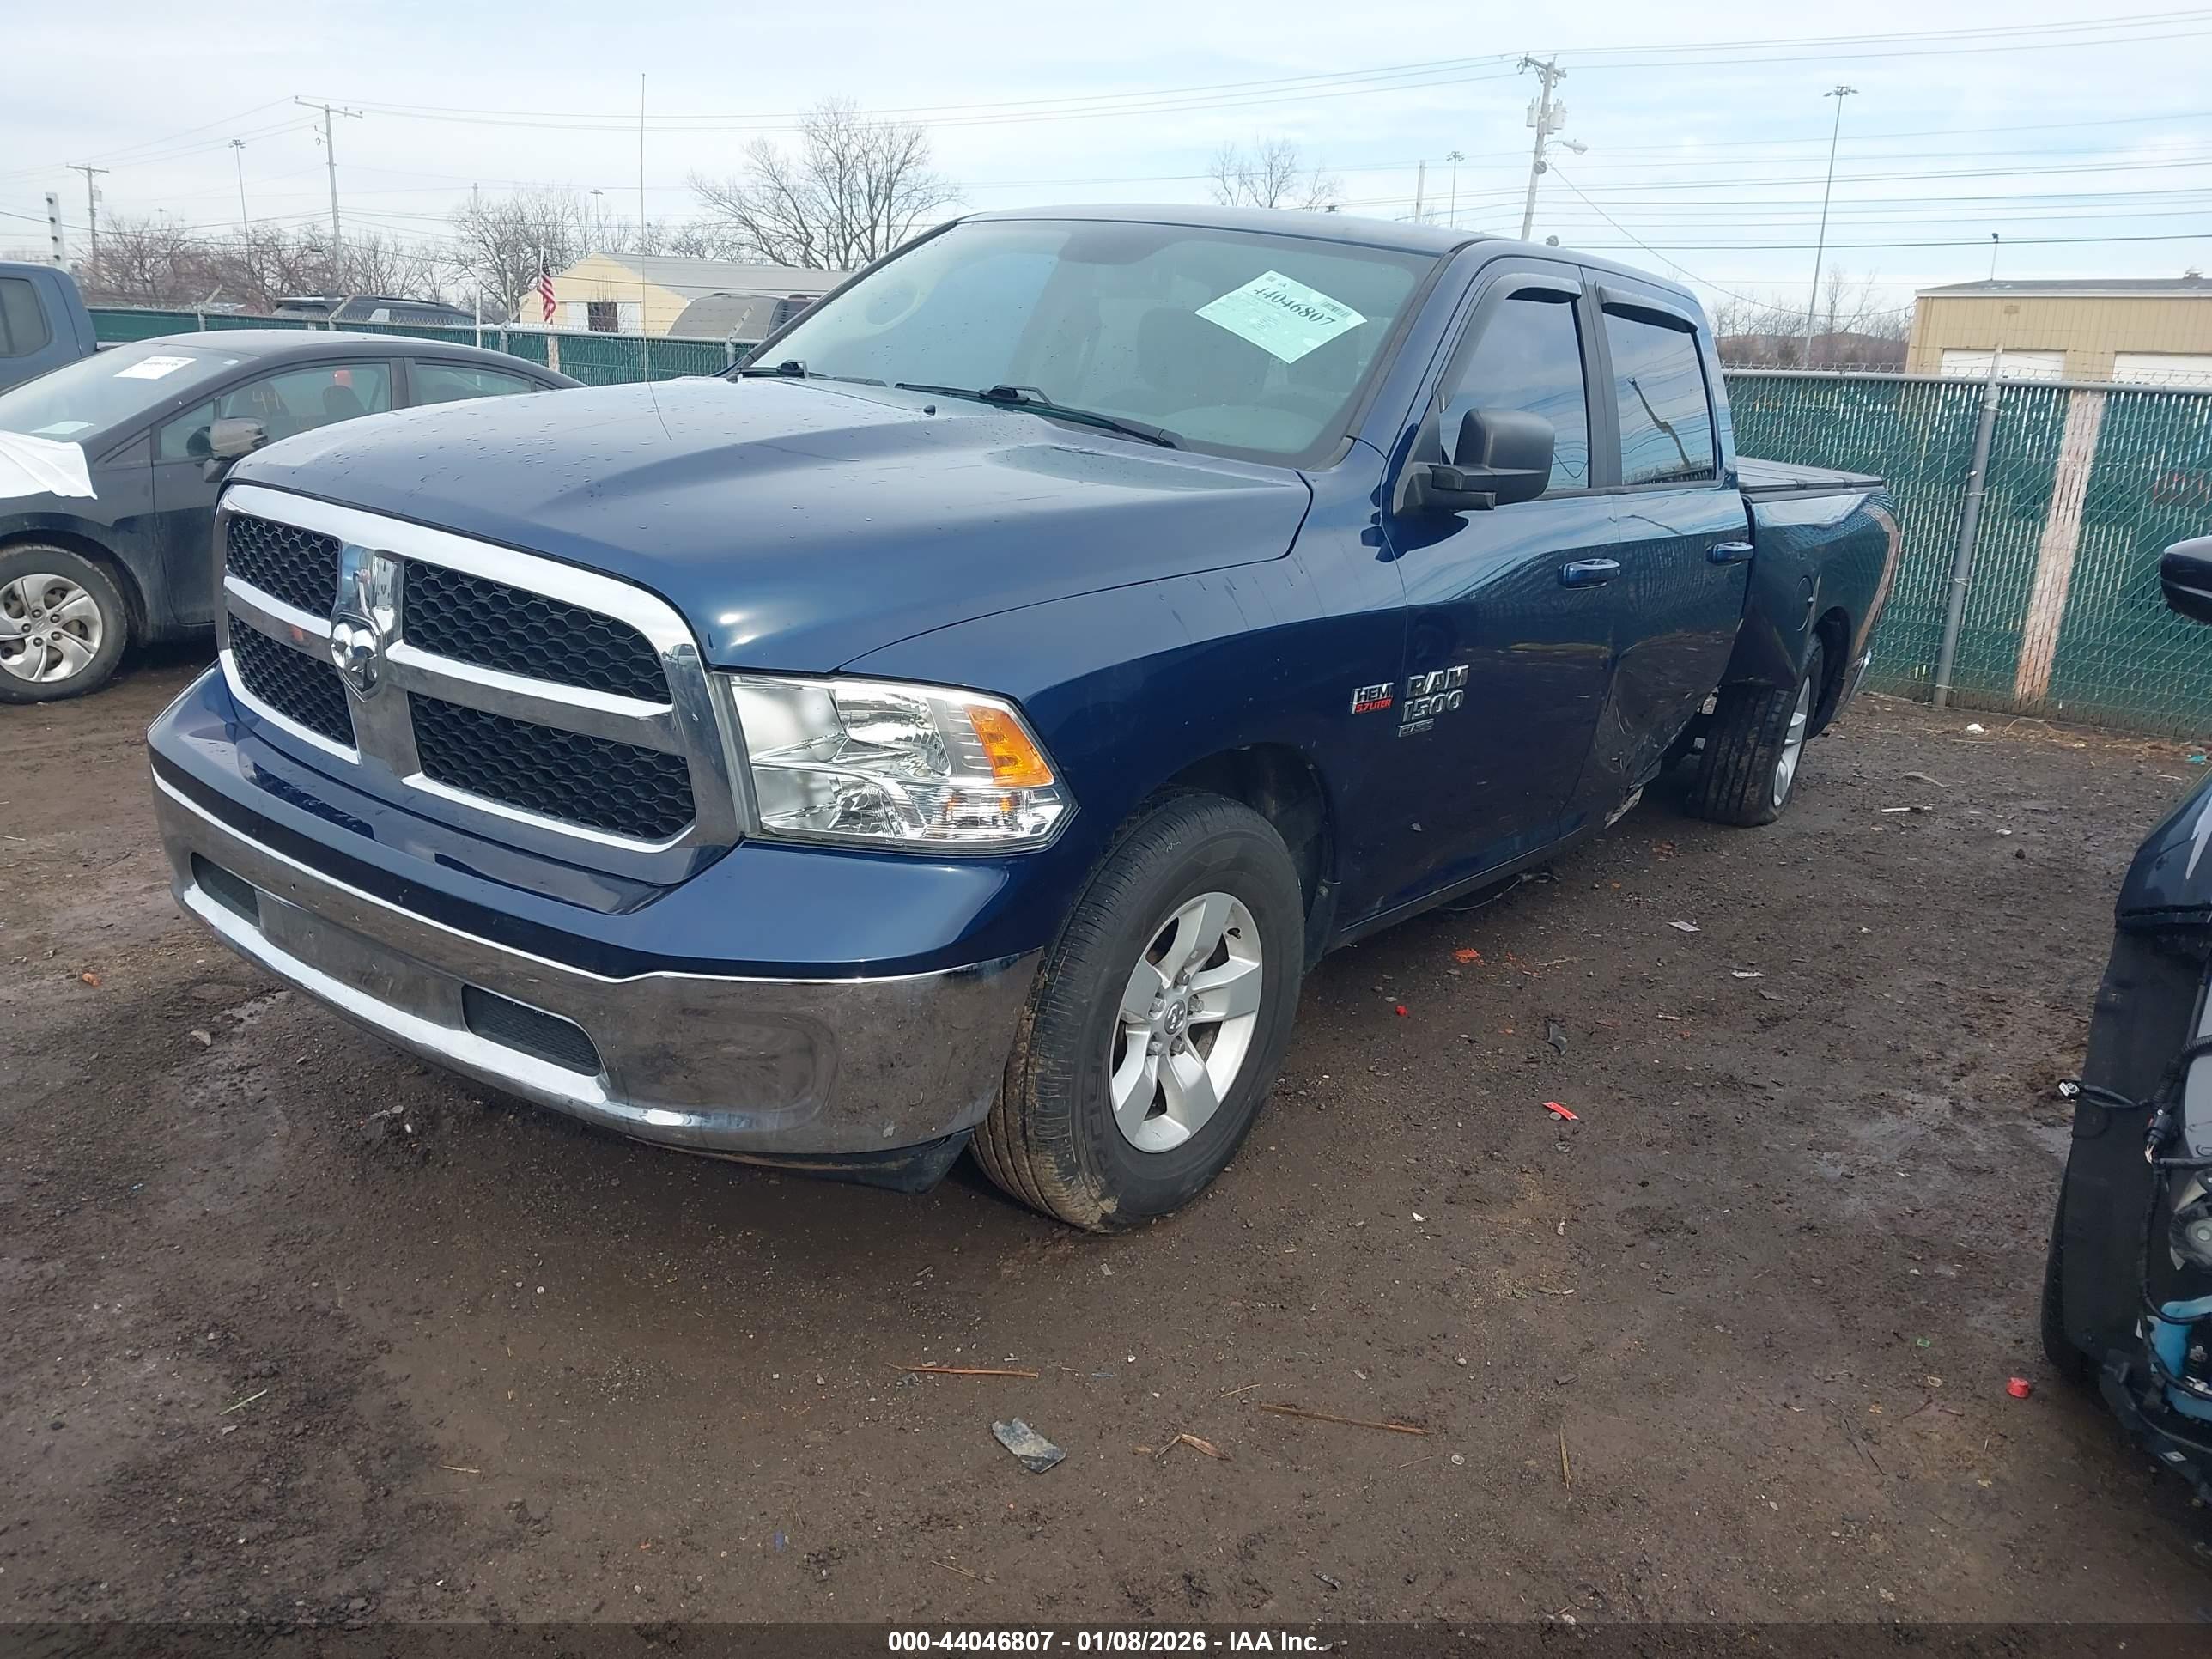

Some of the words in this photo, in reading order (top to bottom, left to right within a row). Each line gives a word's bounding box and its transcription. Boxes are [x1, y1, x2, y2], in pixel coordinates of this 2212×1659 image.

[1255, 288, 1336, 326] 44046807
[1406, 665, 1469, 698] RAM
[1402, 689, 1464, 722] 1500
